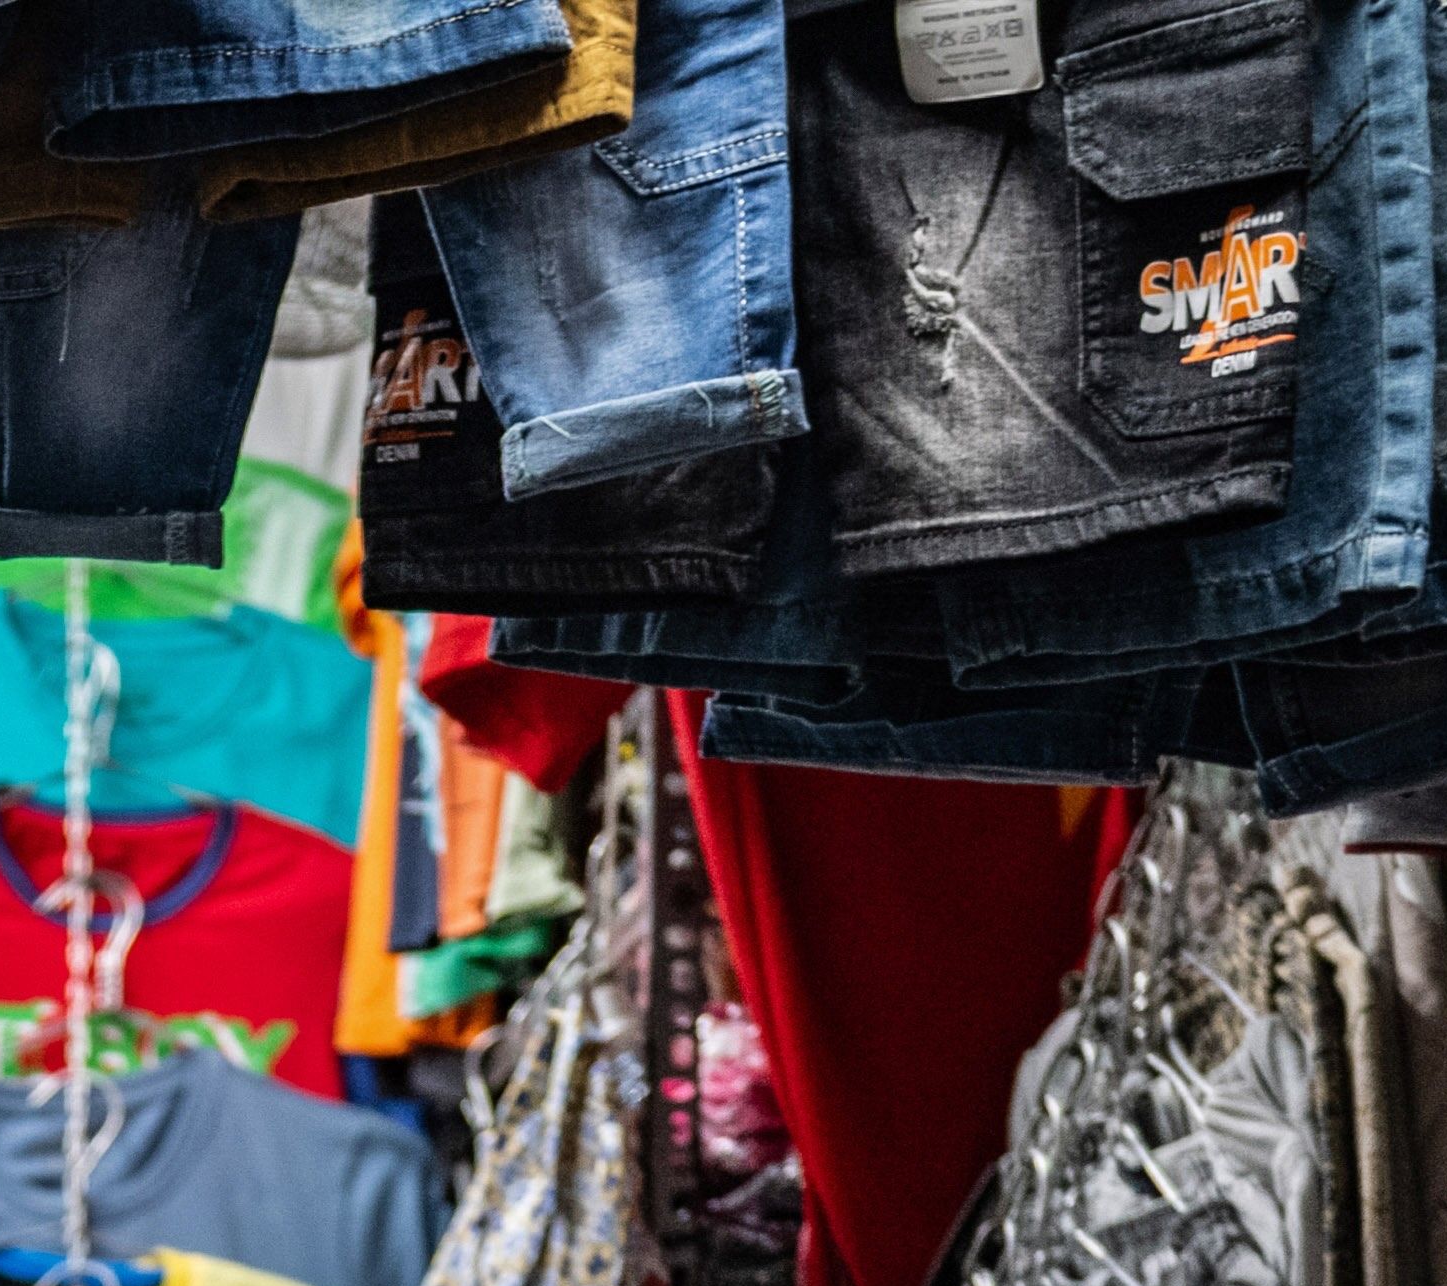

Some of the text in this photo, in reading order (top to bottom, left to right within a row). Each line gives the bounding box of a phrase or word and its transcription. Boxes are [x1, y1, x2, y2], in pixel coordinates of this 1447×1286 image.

[1140, 230, 1306, 334] SMAR
[1211, 350, 1258, 378] DENIM
[376, 443, 420, 463] DENIM
